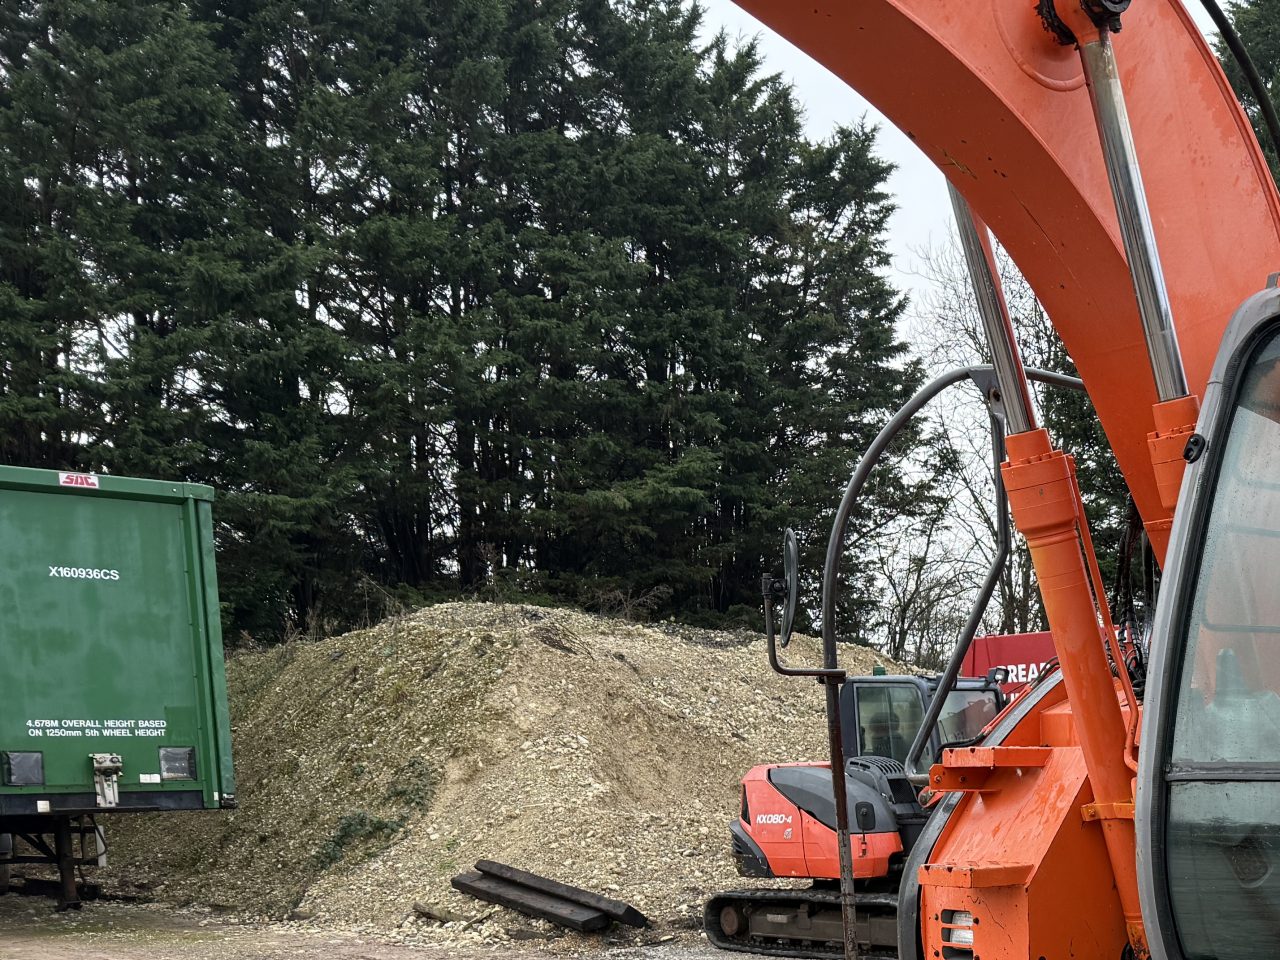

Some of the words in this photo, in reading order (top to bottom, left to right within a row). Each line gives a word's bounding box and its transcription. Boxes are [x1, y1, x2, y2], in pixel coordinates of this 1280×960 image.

[62, 474, 97, 487] SDC
[48, 566, 120, 581] X160936CS
[61, 719, 102, 728] OVERALL
[104, 719, 136, 728] HEIGHT
[138, 719, 167, 728] BASED
[28, 728, 43, 737] ON
[45, 728, 82, 737] 1250mm
[84, 728, 100, 737] 5th
[102, 728, 133, 737] WHEEL
[134, 728, 166, 737] HEIGHT
[756, 814, 793, 824] KX080-4
